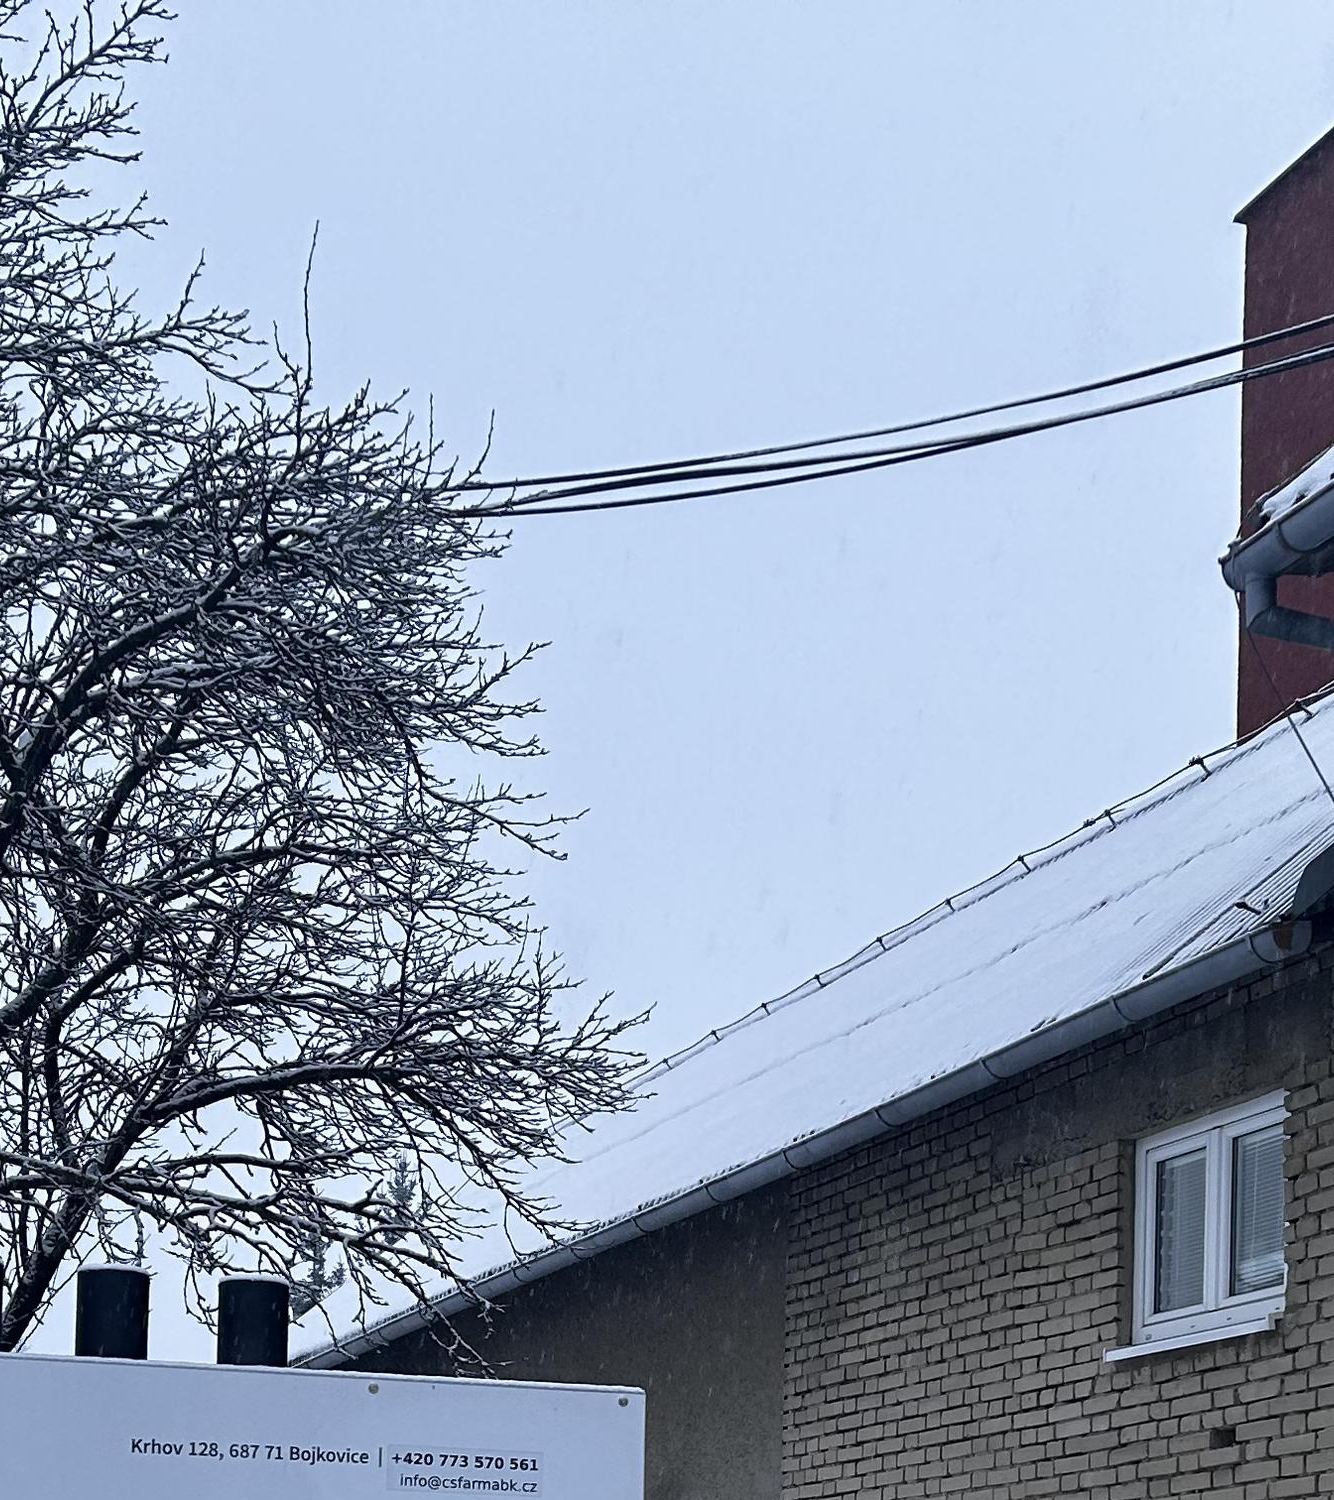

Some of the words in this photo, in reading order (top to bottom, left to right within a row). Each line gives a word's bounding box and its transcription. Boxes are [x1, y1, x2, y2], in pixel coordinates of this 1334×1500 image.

[131, 1438, 184, 1456] Krhov
[189, 1441, 225, 1461] 128,
[230, 1443, 260, 1460] 687
[264, 1445, 284, 1461] 71
[290, 1445, 370, 1466] Bojkovice
[391, 1452, 434, 1467] +420
[438, 1453, 469, 1468] 773
[473, 1455, 505, 1470] 570
[509, 1457, 539, 1472] 561
[399, 1472, 538, 1494] info@csfarmabk.cz
